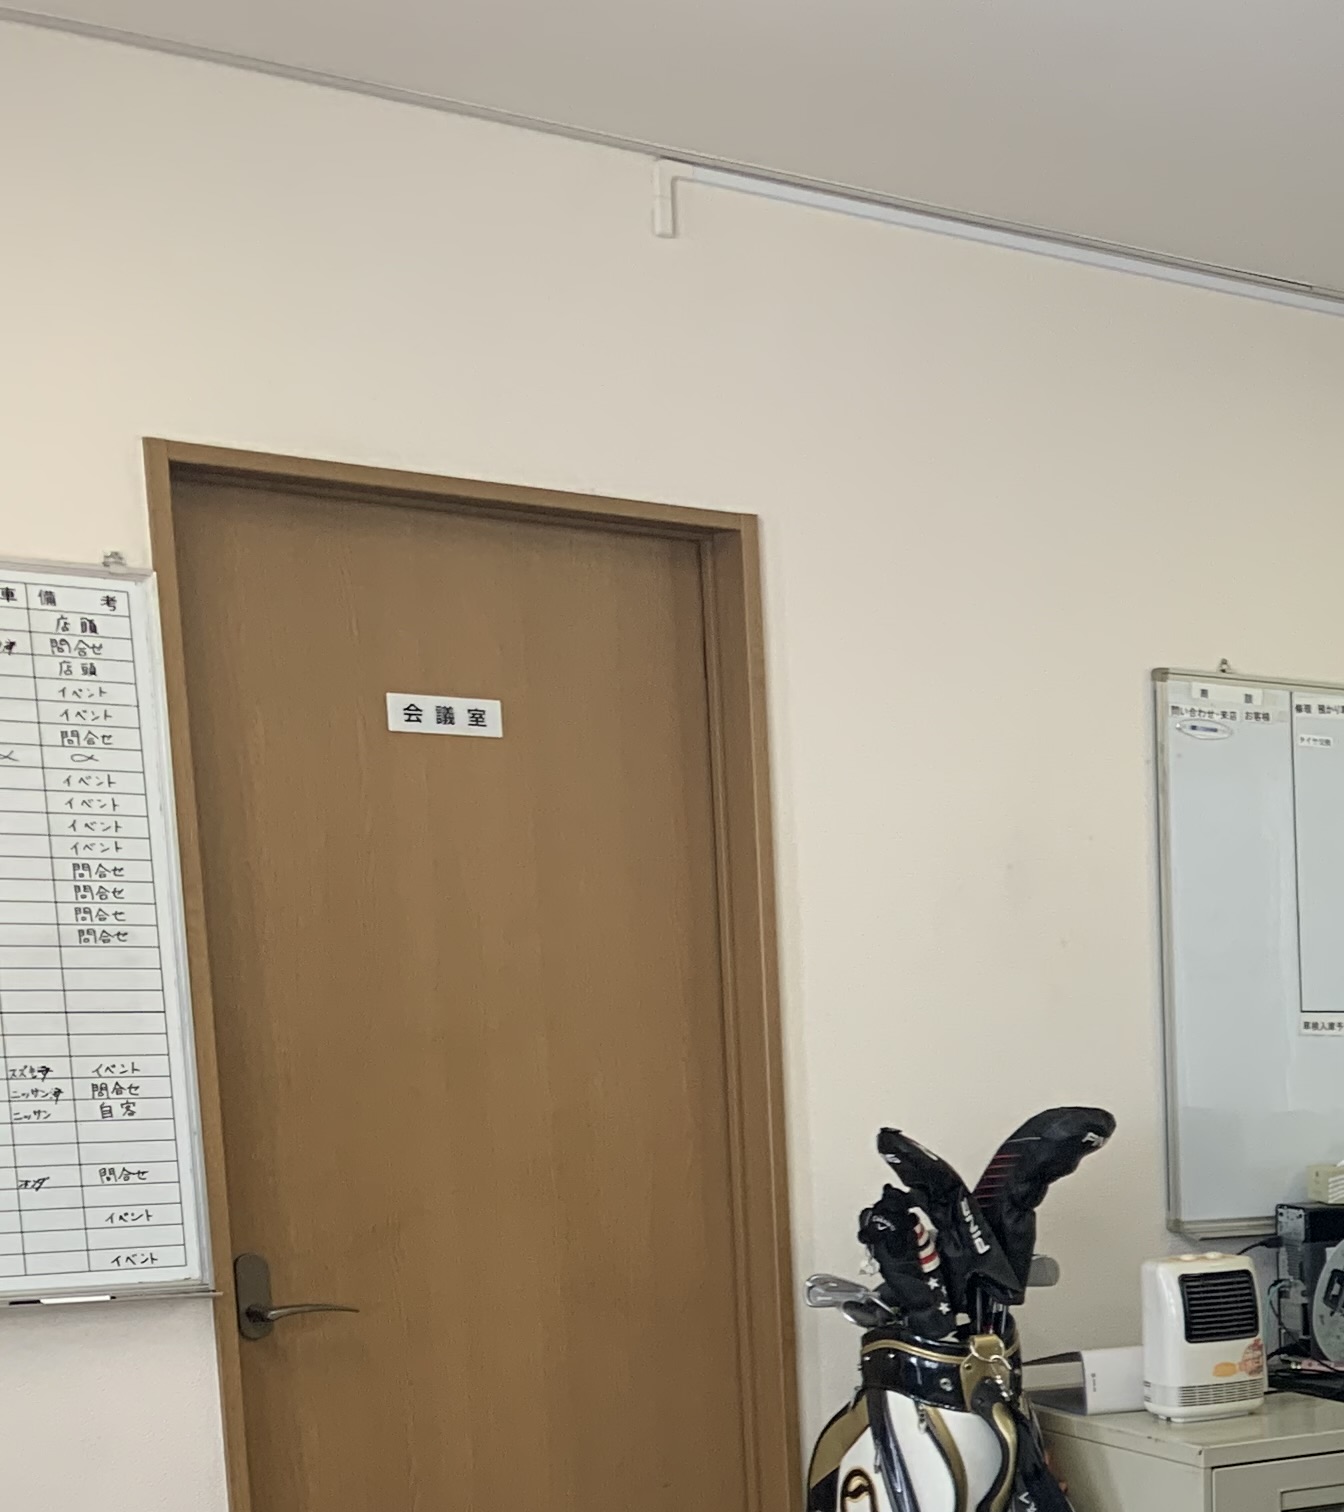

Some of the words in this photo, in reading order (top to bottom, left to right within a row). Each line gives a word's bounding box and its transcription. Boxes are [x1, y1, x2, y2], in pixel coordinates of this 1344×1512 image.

[50, 638, 103, 656] 問合せ
[58, 661, 98, 677] 店頭
[58, 686, 107, 698] イベント
[59, 709, 112, 722] イベント
[403, 703, 487, 728] 会議室
[60, 730, 113, 746] 問合せ
[62, 775, 116, 788] イベント
[64, 798, 120, 811] イベント
[67, 820, 123, 833] イベント
[70, 842, 123, 854] イベント
[72, 862, 125, 879] 問合せ
[74, 884, 125, 901] 問合せ
[75, 906, 127, 923] 問合せ
[77, 928, 129, 945] 問合せ
[91, 1063, 141, 1076] イベント
[91, 1082, 140, 1099] 問合せ
[99, 1167, 149, 1183] 問合せ
[105, 1209, 153, 1223] イベント
[110, 1253, 158, 1266] イベント
